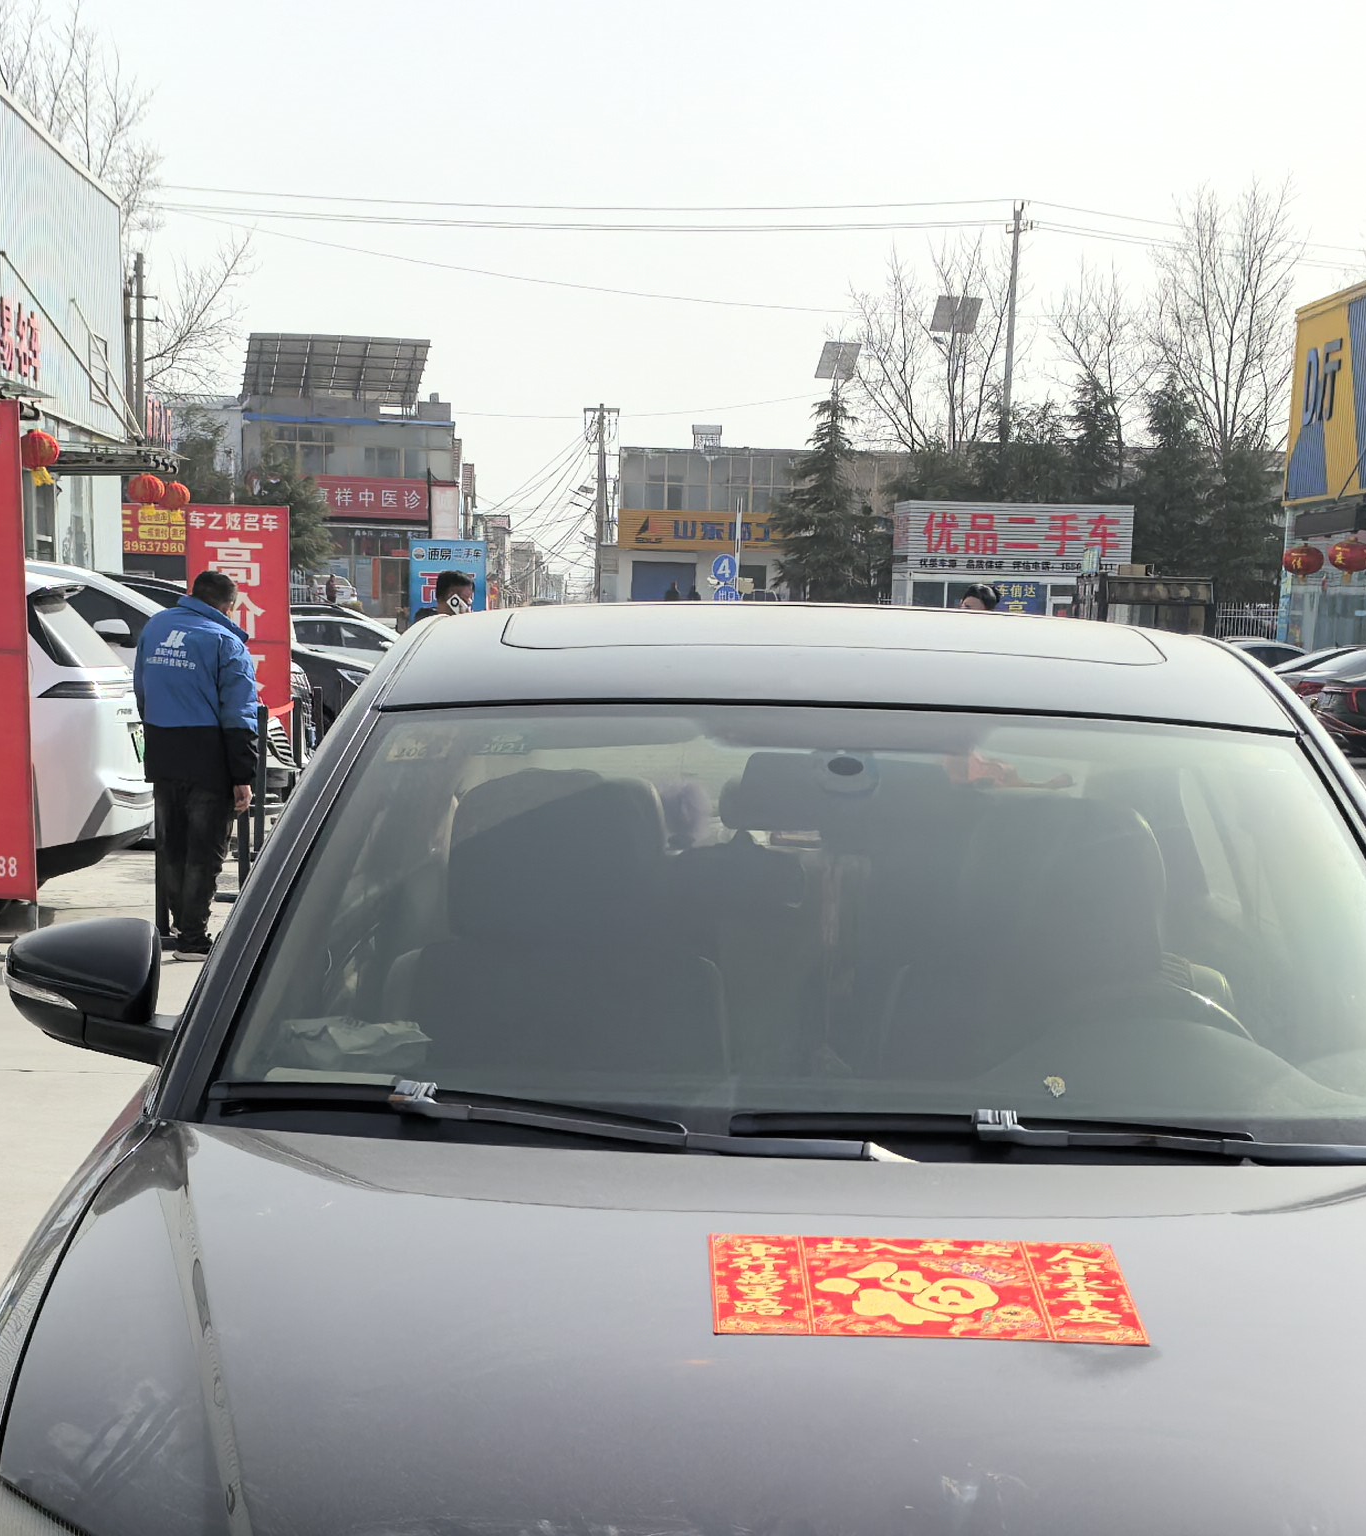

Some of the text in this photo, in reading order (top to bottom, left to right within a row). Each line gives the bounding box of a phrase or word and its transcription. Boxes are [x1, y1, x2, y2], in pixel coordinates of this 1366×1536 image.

[317, 487, 430, 510] 康祥中医诊
[189, 511, 279, 532] 车之炫名车
[923, 511, 1121, 557] 优品二手车
[717, 558, 731, 578] 4
[997, 584, 1037, 599] 车信达
